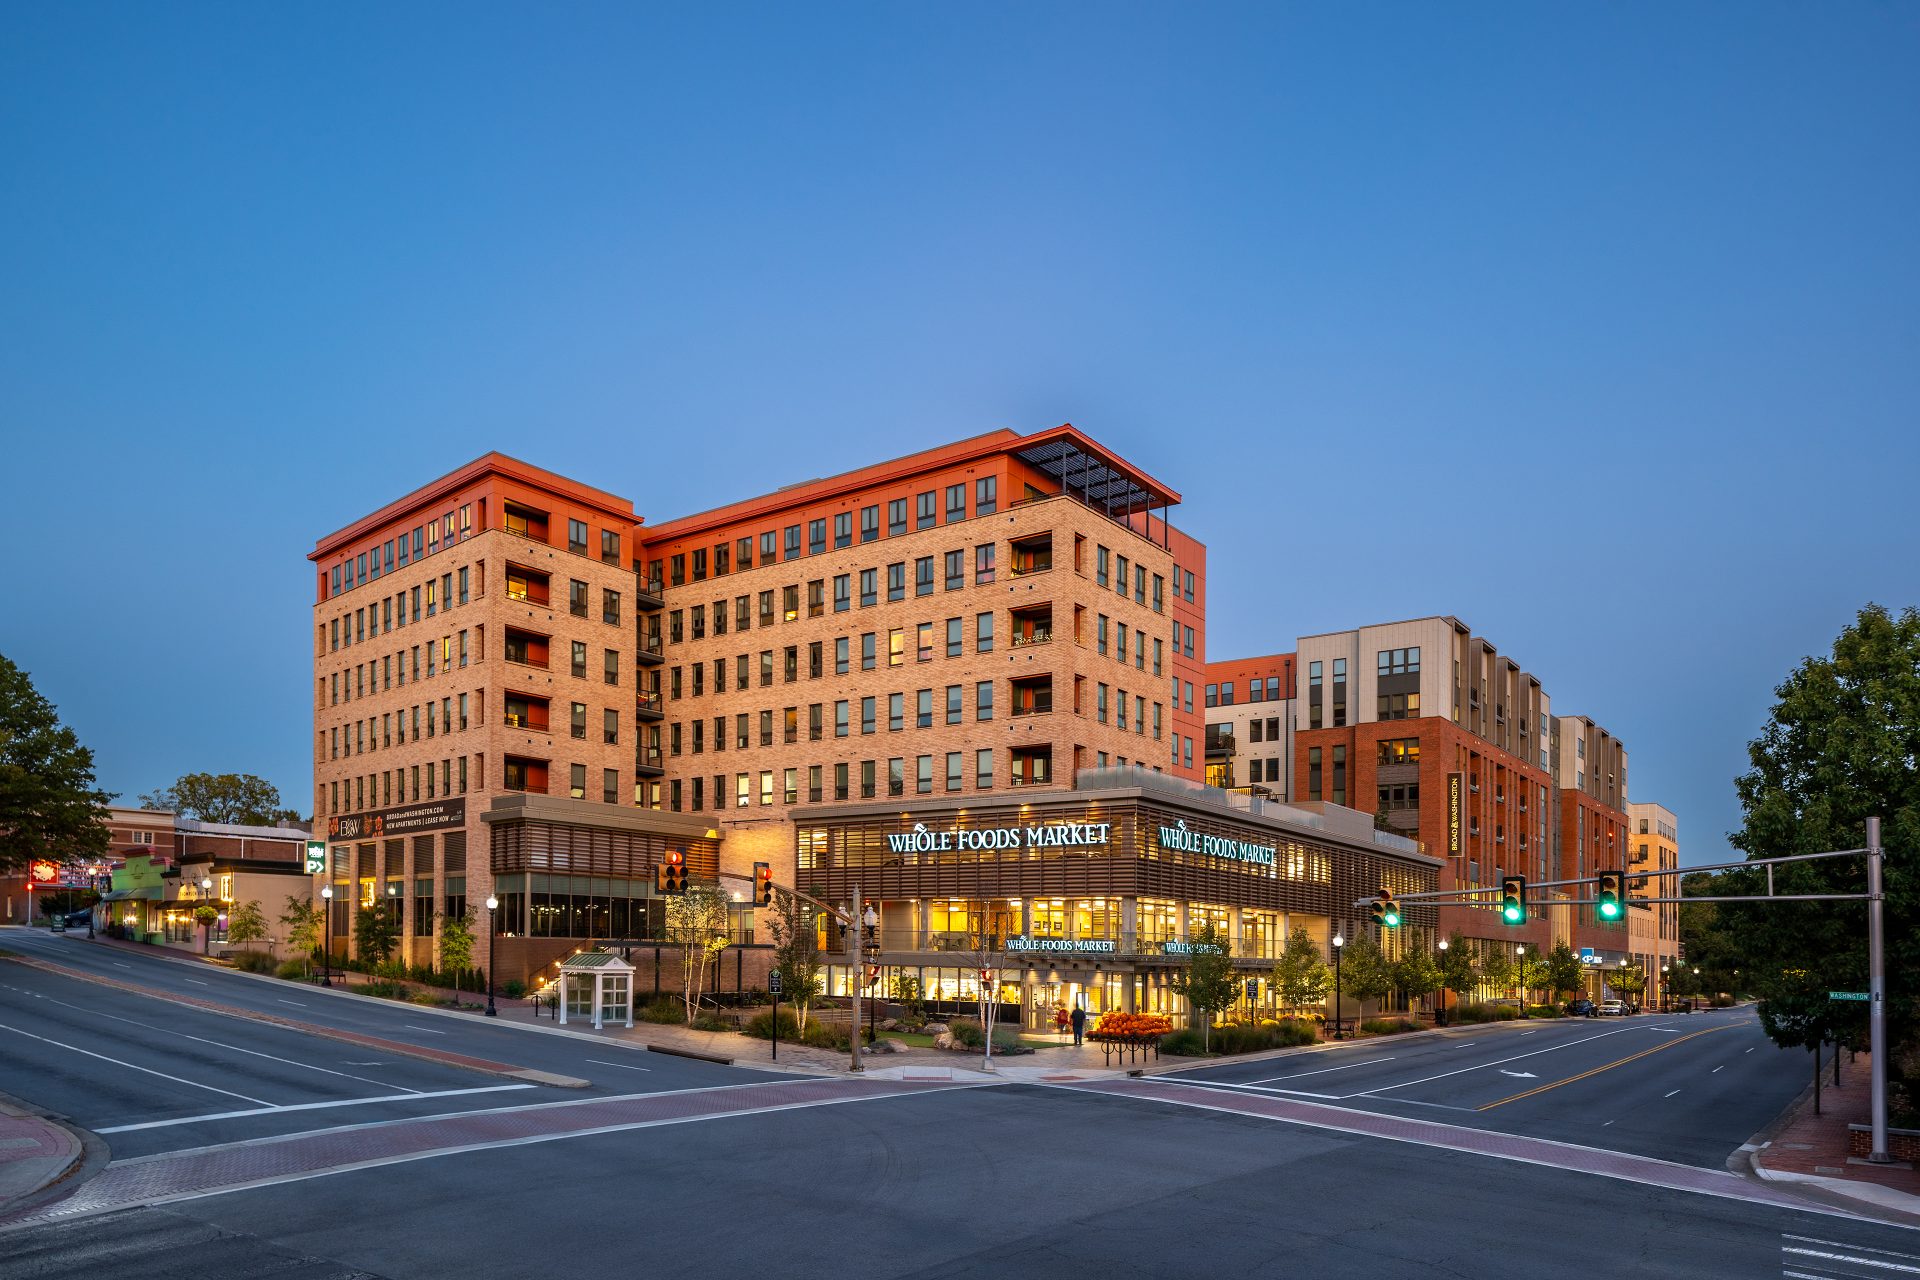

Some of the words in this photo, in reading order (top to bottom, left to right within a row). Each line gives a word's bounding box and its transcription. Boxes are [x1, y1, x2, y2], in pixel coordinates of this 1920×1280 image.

[395, 819, 422, 828] APARTMENTS
[425, 816, 438, 825] LEASE
[439, 815, 450, 823] NOW
[887, 823, 951, 852] WHOLE
[957, 828, 1021, 850] FOODS
[1026, 823, 1110, 848] MARKET
[1160, 820, 1201, 853] WHOLE
[1203, 835, 1237, 859] FOODS
[1238, 842, 1276, 865] MARKET
[1006, 935, 1040, 950] WHOLE
[1041, 940, 1073, 951] FOODS
[1074, 940, 1115, 952] MARKET
[1165, 938, 1186, 953] WHOLE
